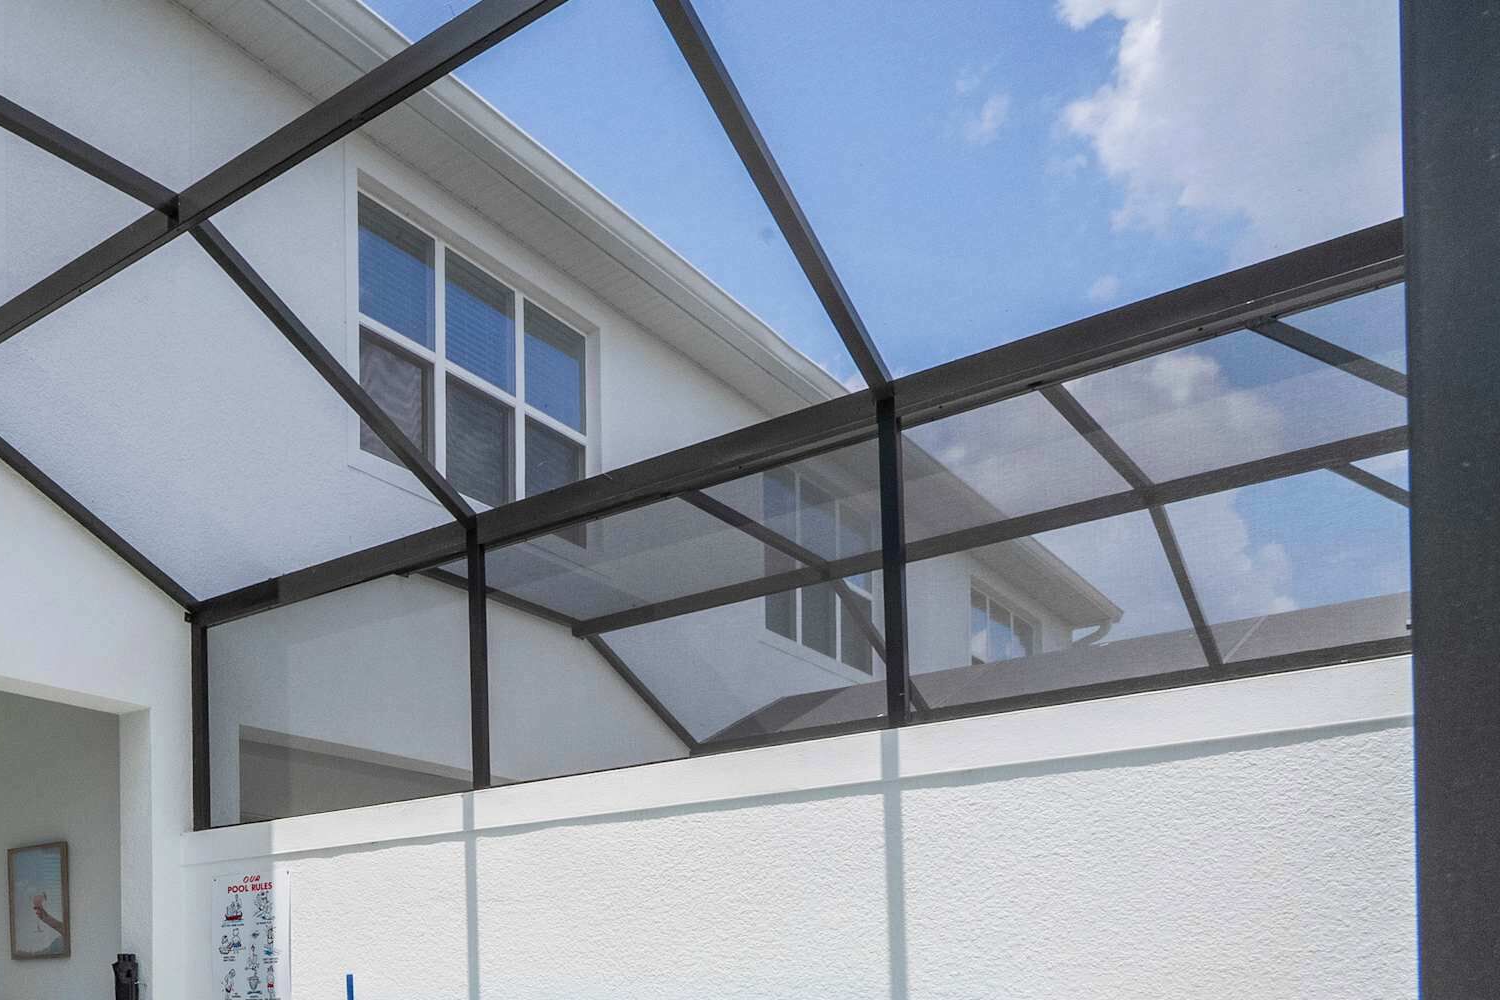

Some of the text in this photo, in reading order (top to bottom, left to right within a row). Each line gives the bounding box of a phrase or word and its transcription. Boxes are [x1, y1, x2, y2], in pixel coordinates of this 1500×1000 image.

[243, 875, 260, 883] OUR
[227, 881, 273, 894] POOL RULES
